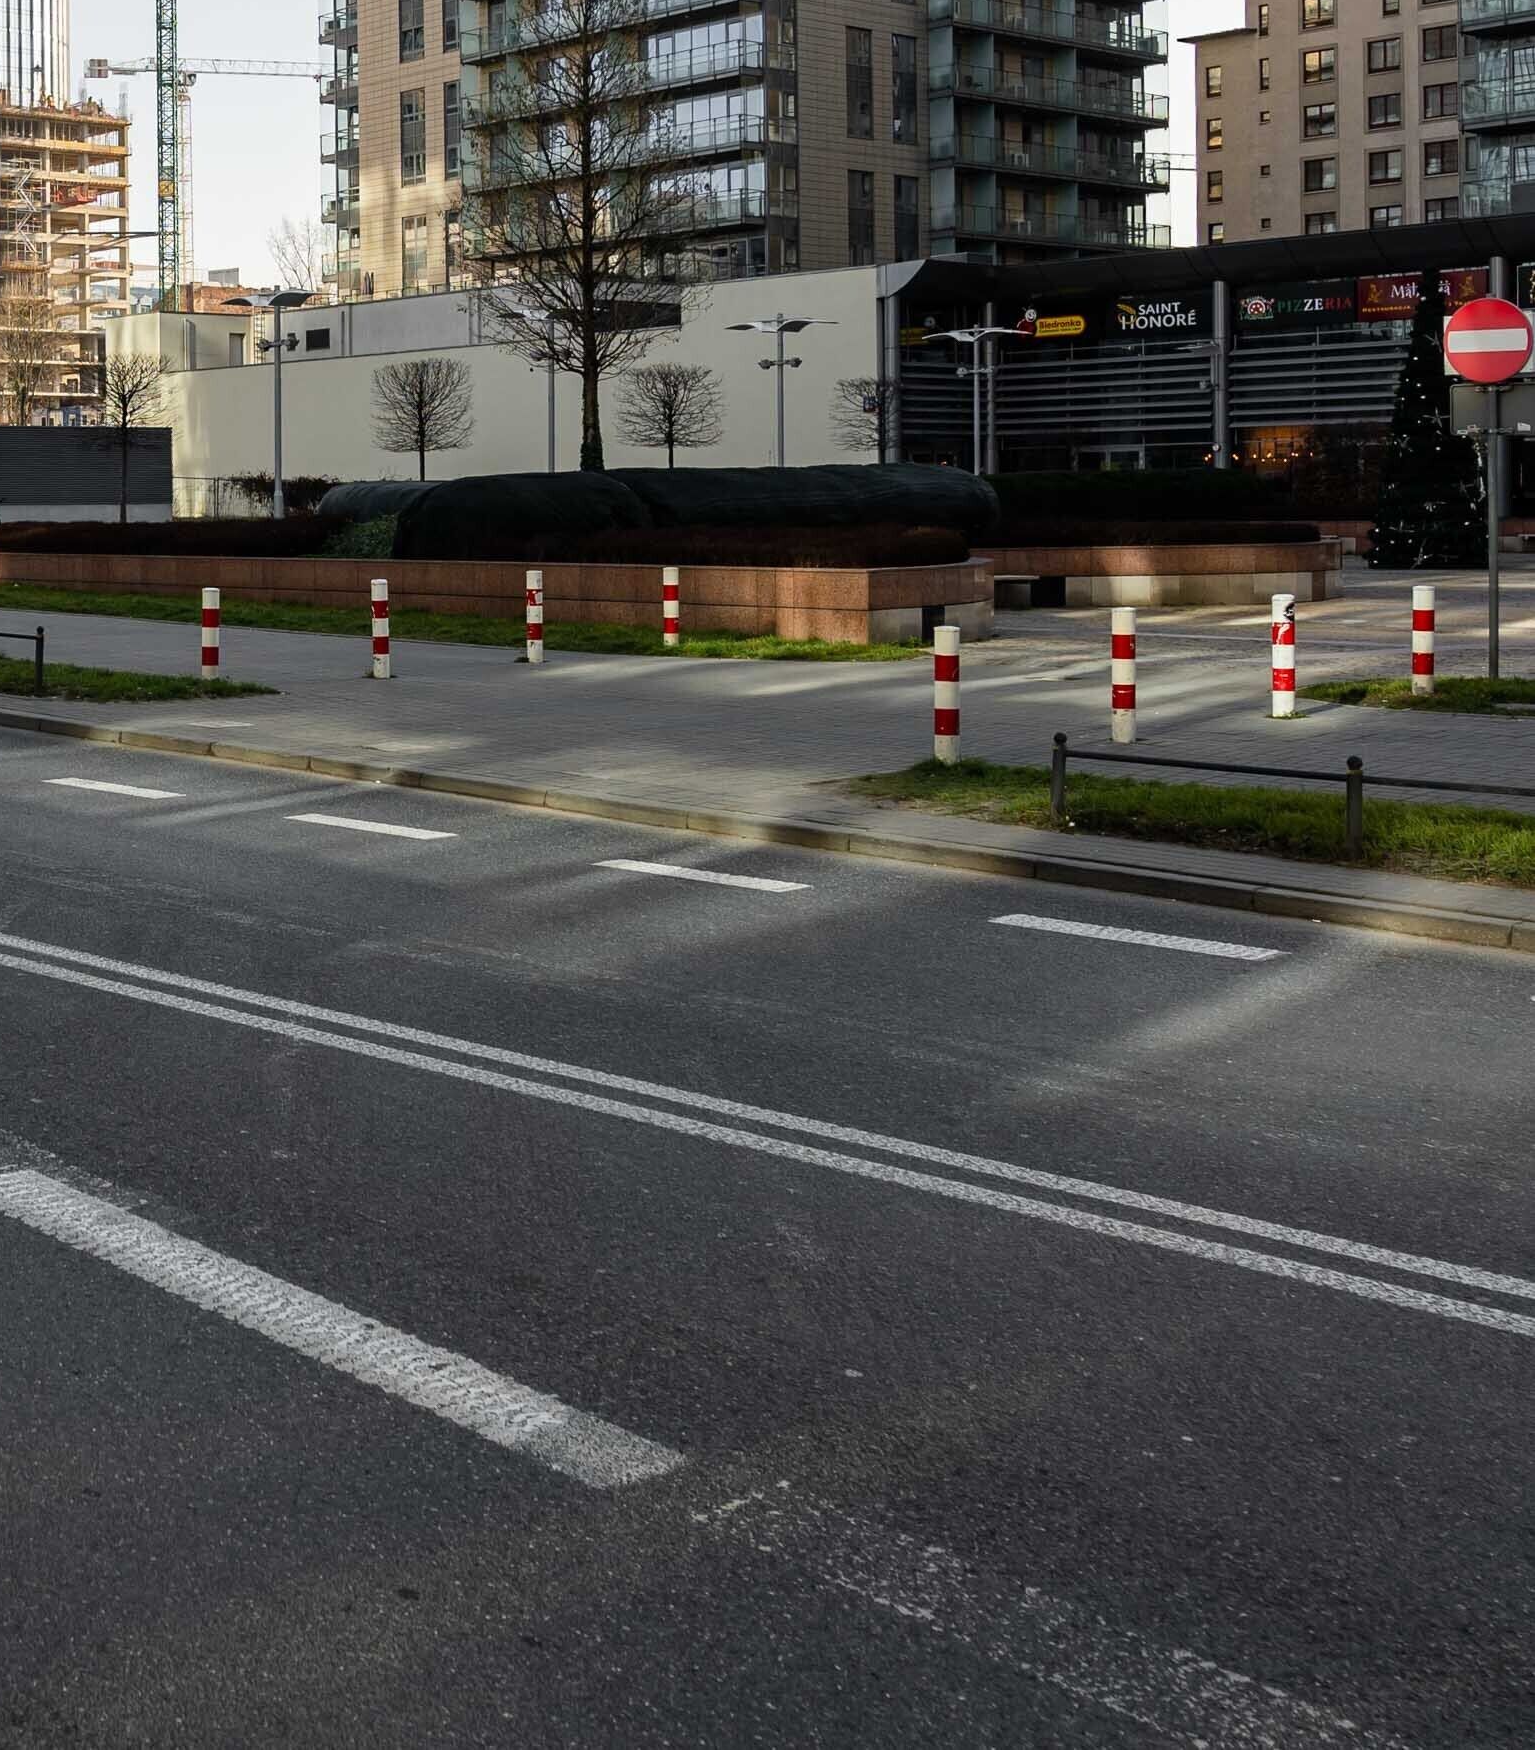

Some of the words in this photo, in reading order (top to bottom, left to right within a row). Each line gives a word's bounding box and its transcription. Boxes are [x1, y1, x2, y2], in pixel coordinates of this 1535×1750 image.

[1138, 302, 1181, 315] SAINT
[1276, 297, 1353, 313] PIZZERIA
[1039, 319, 1082, 331] Biedronka
[1121, 309, 1197, 330] HONORÉ
